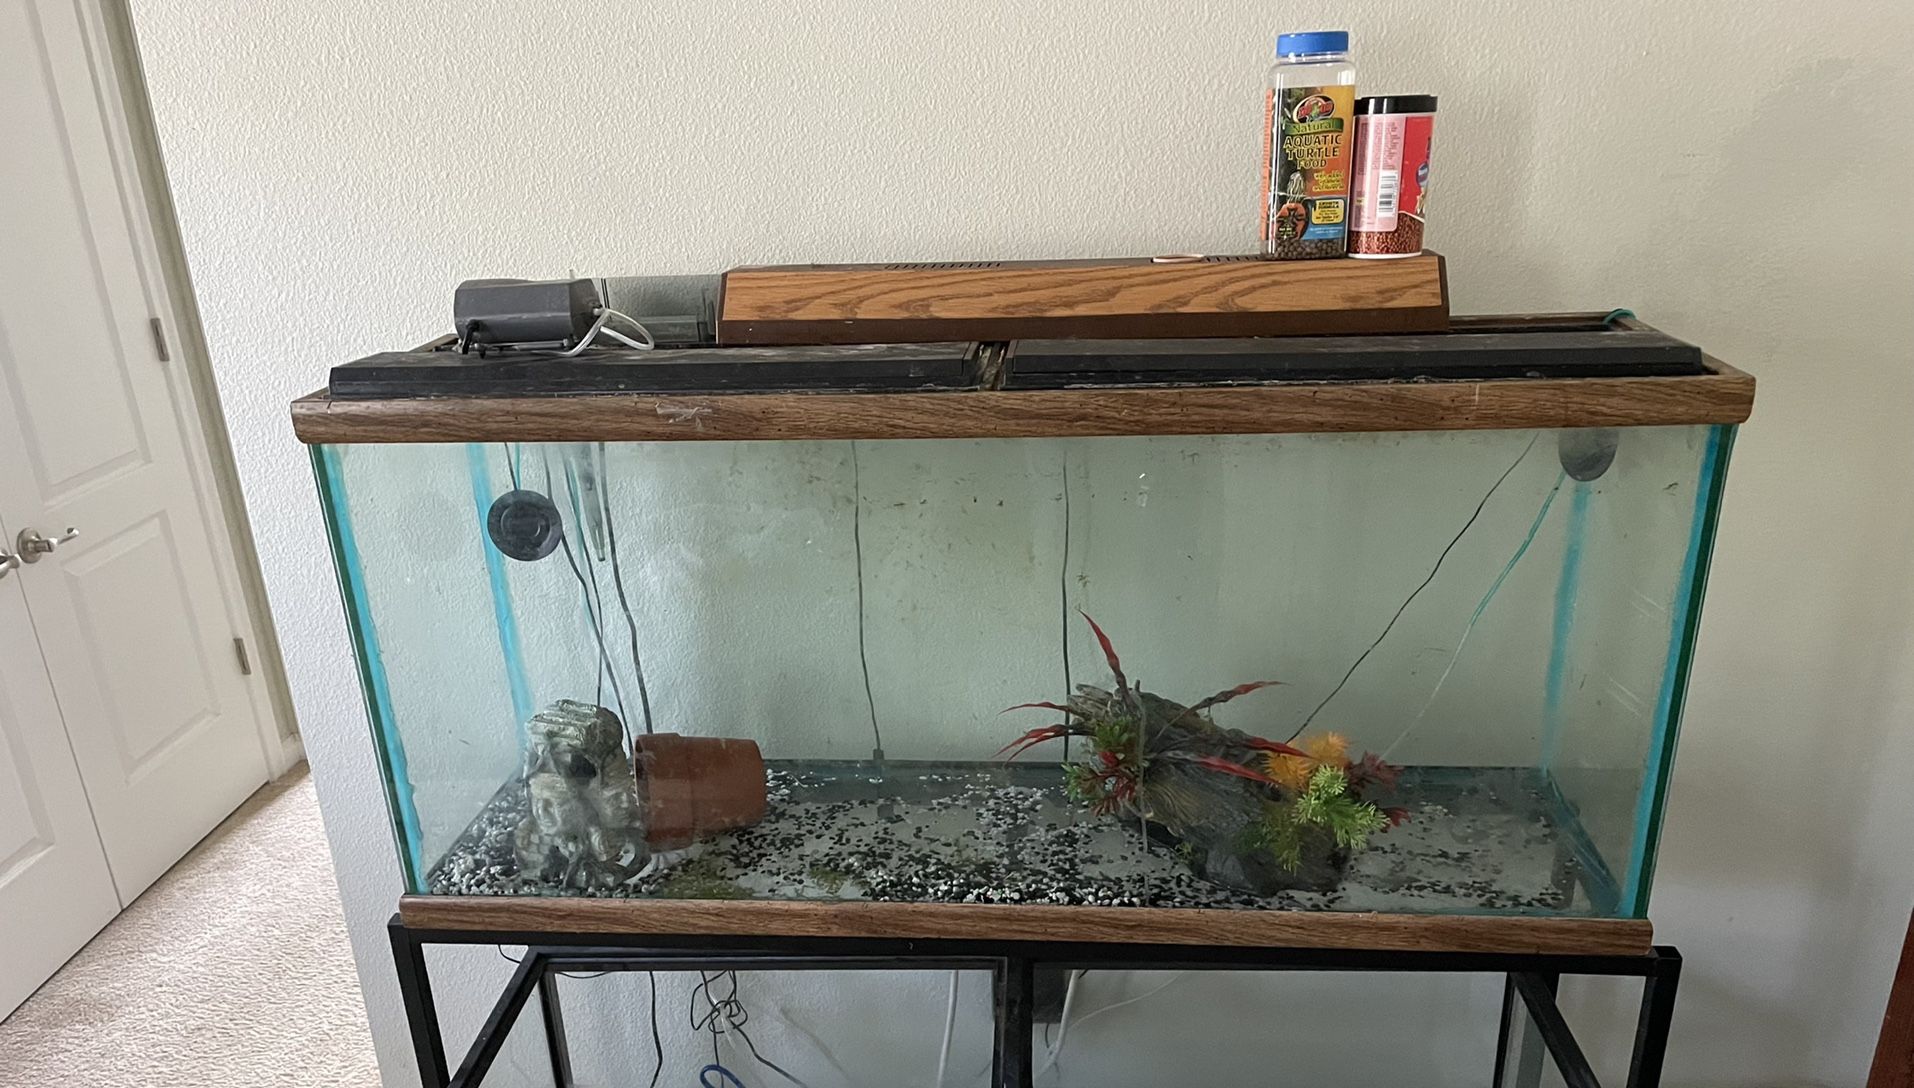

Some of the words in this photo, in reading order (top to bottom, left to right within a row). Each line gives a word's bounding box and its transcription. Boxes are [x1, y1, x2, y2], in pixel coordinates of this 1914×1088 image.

[1293, 119, 1334, 133] Natural
[1283, 134, 1342, 148] AQUATIC
[1286, 147, 1340, 160] TURTLE
[1297, 159, 1328, 170] FOOD
